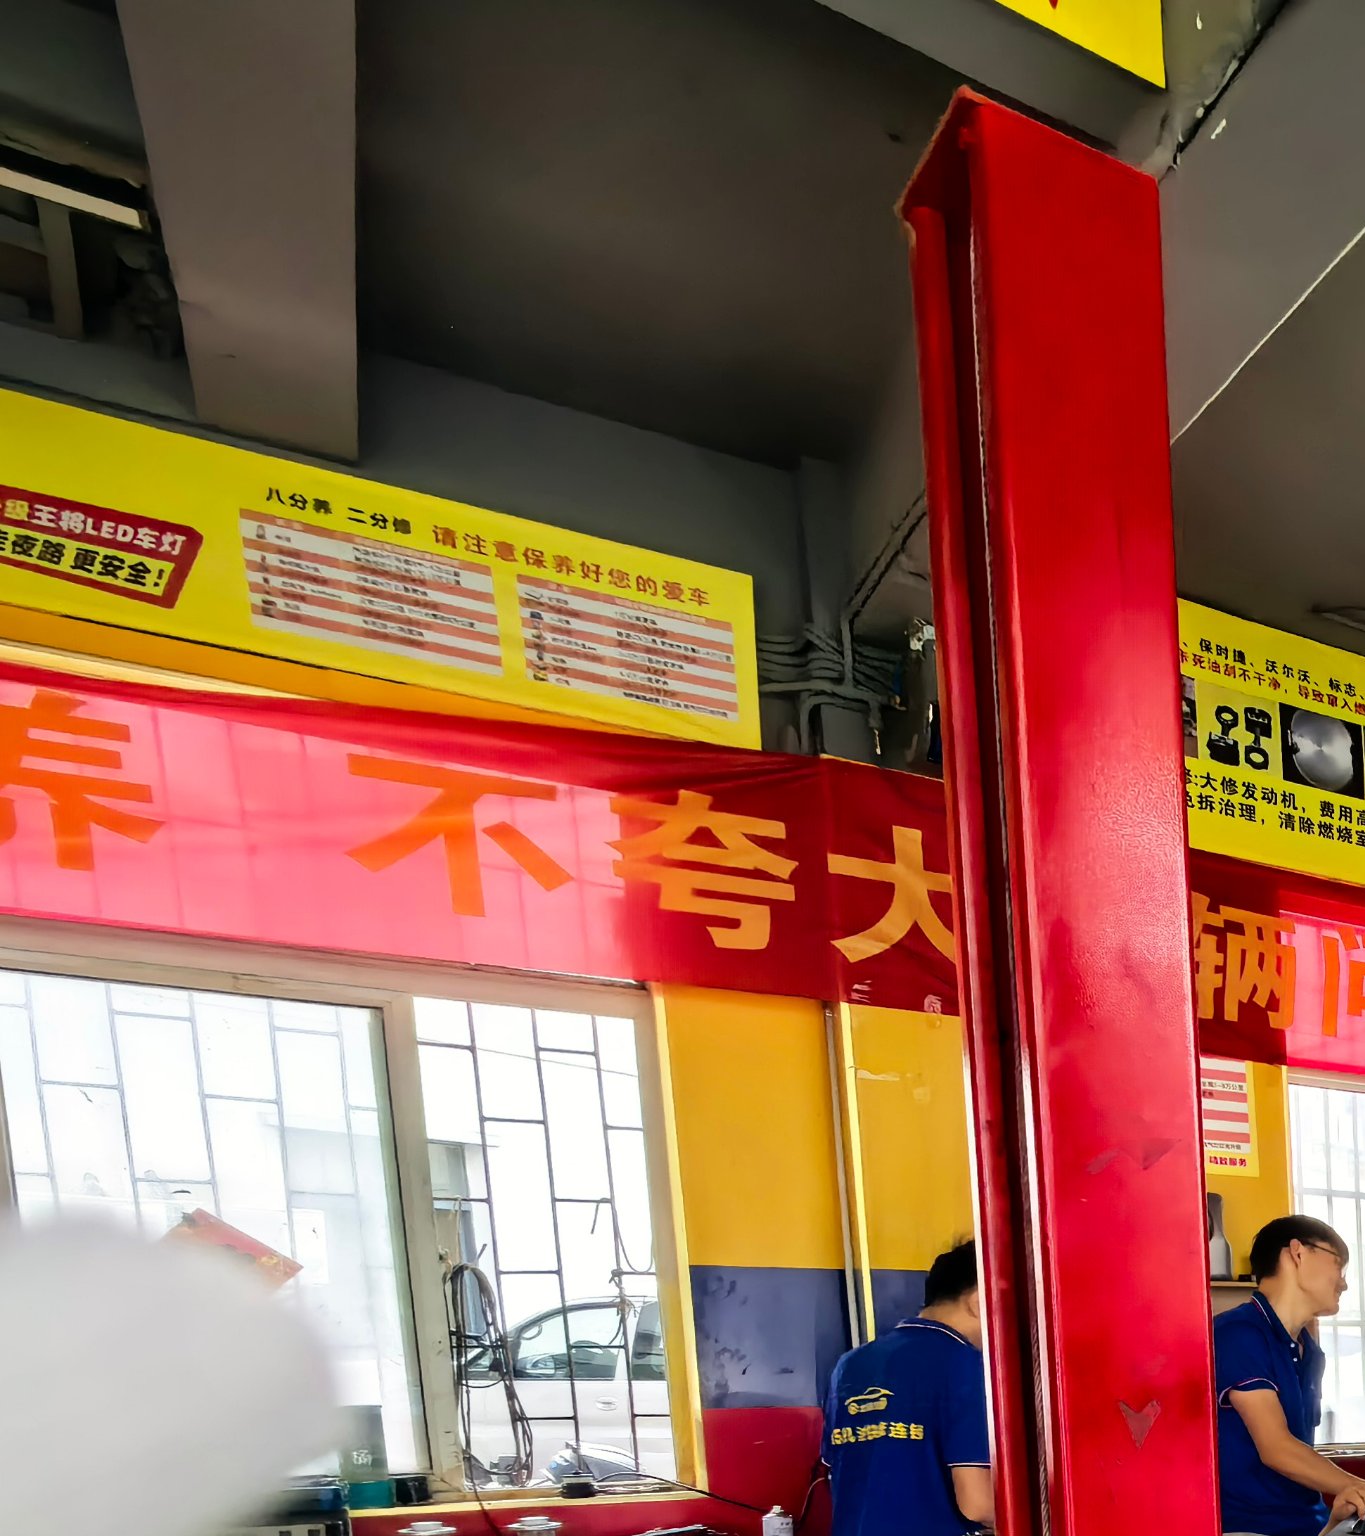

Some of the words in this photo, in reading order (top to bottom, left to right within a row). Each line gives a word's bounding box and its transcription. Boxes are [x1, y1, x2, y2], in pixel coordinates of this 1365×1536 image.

[0, 499, 187, 555] 级王将LED车灯
[432, 525, 711, 607] 请注意保养好您的爱车
